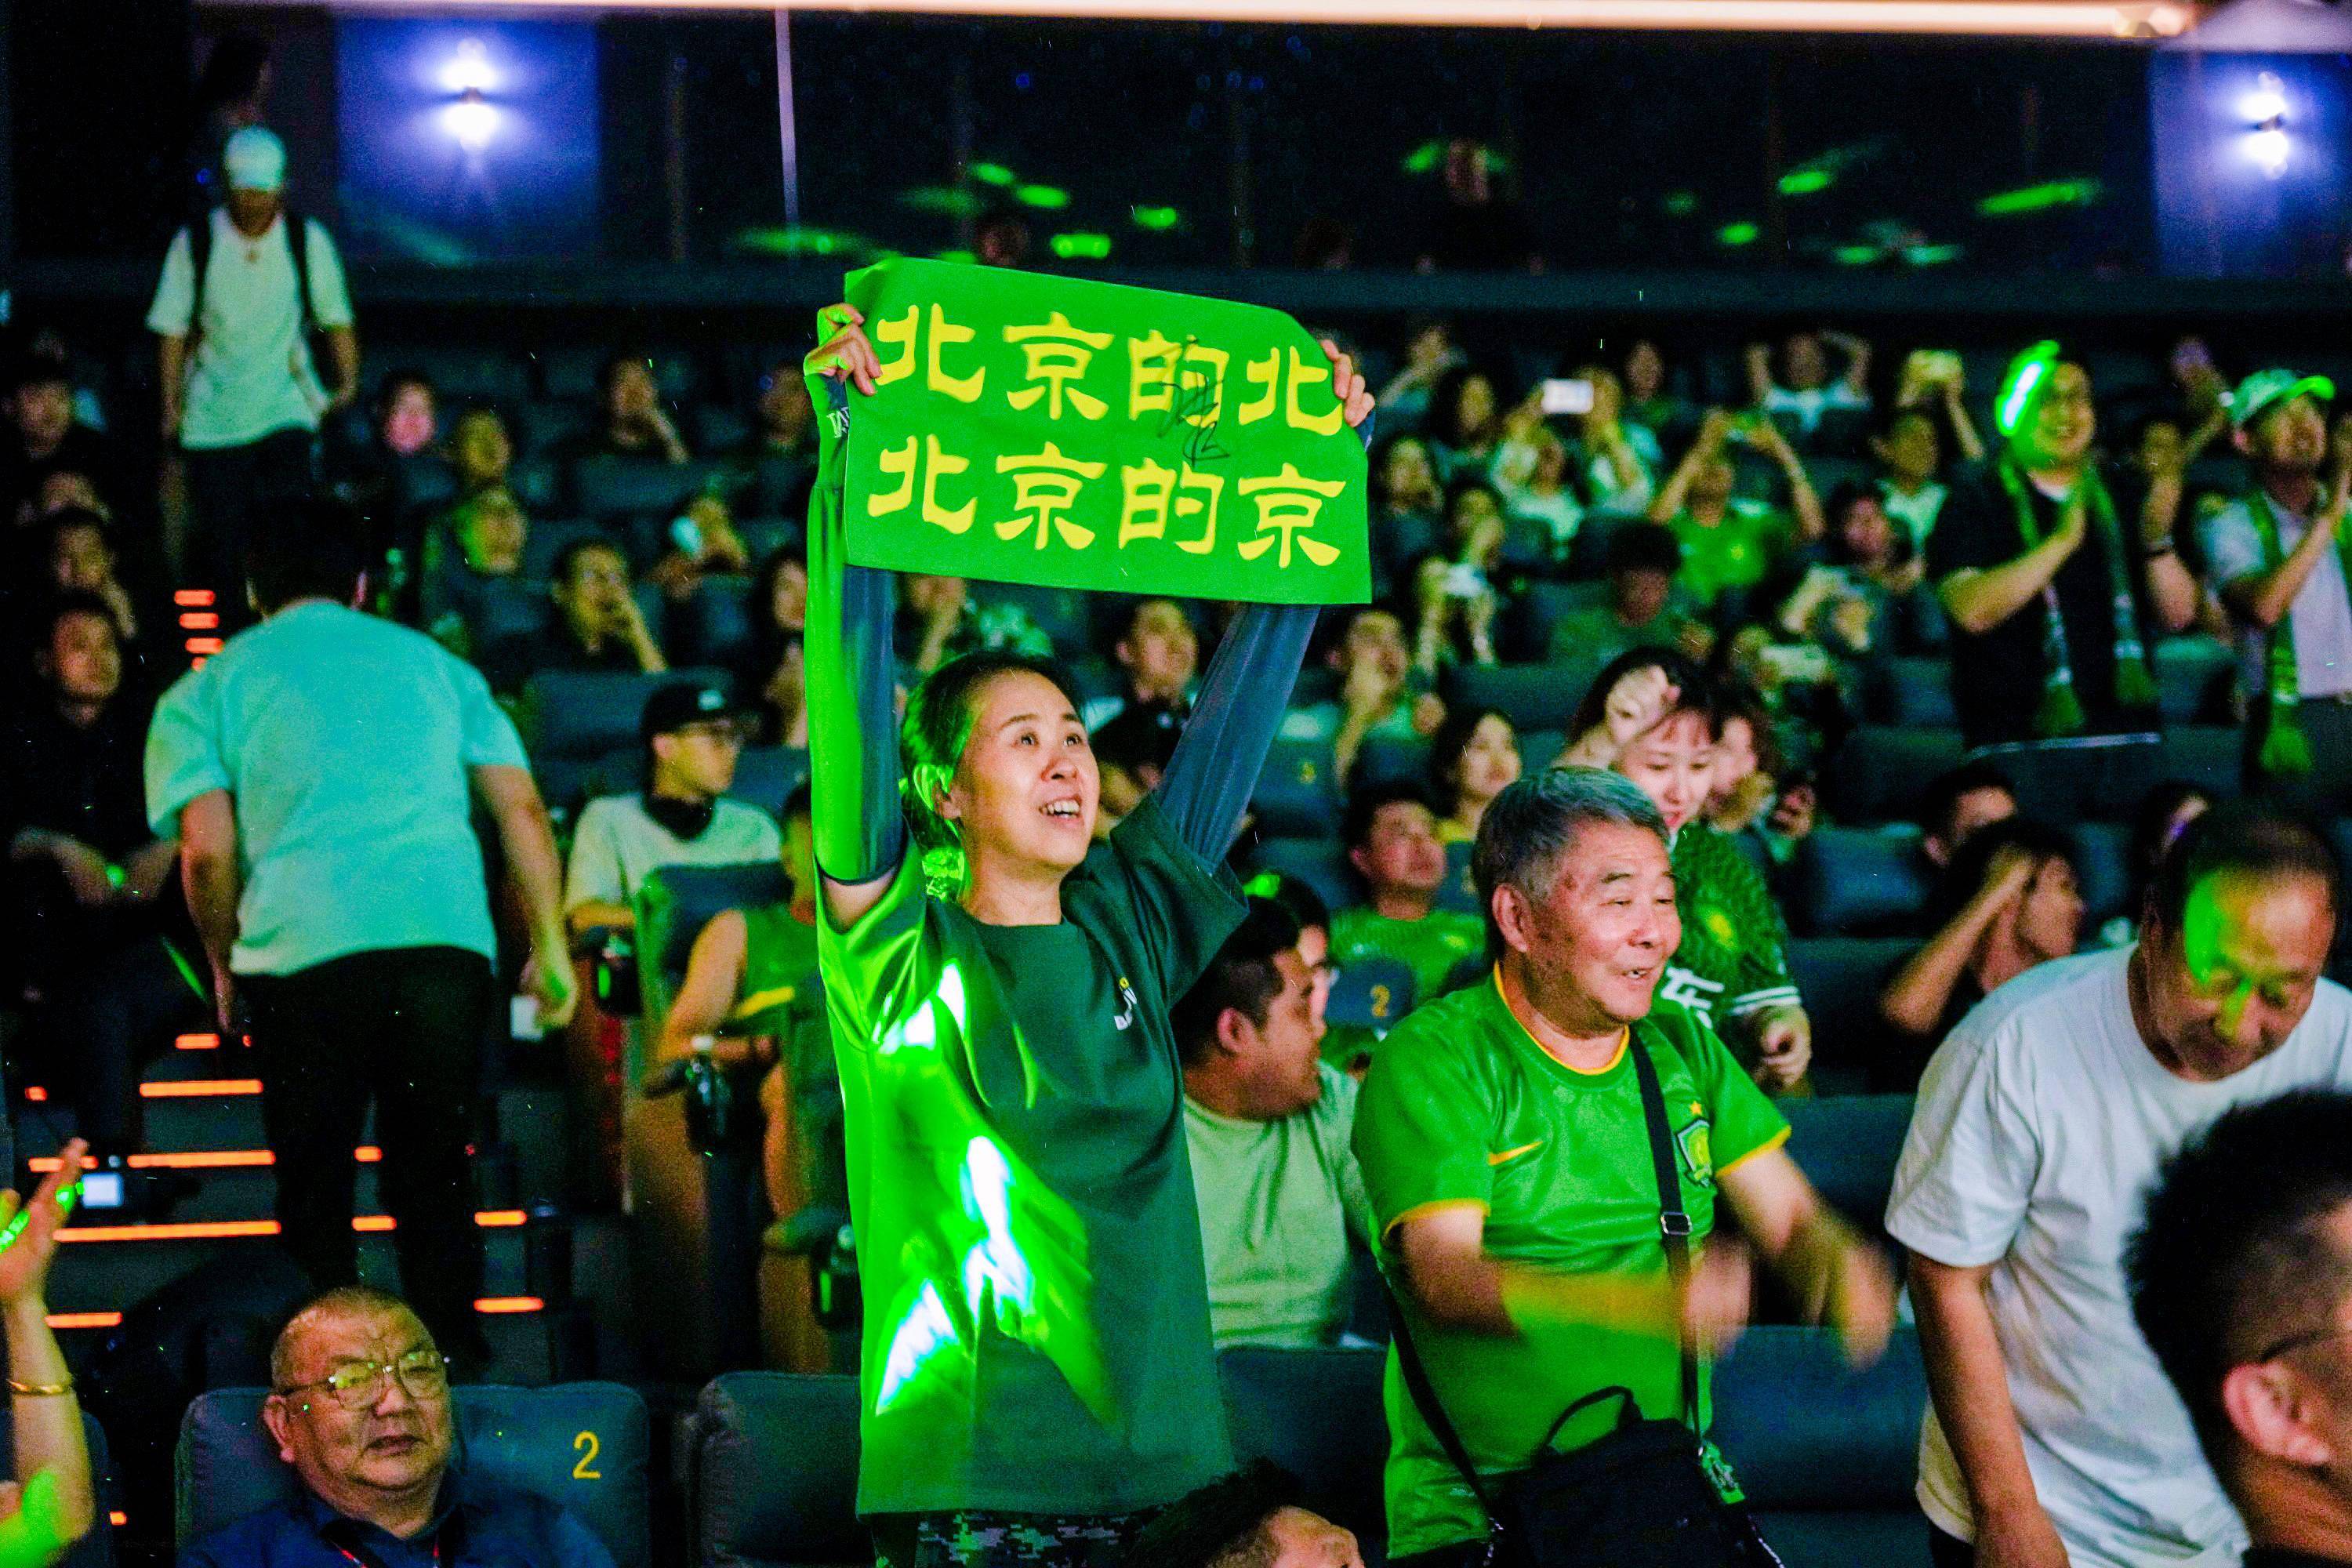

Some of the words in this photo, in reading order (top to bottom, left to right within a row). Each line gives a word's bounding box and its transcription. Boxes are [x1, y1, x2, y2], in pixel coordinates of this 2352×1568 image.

[874, 303, 1344, 436] 北京的北
[867, 434, 1347, 569] 北京的京
[572, 1430, 601, 1479] 2
